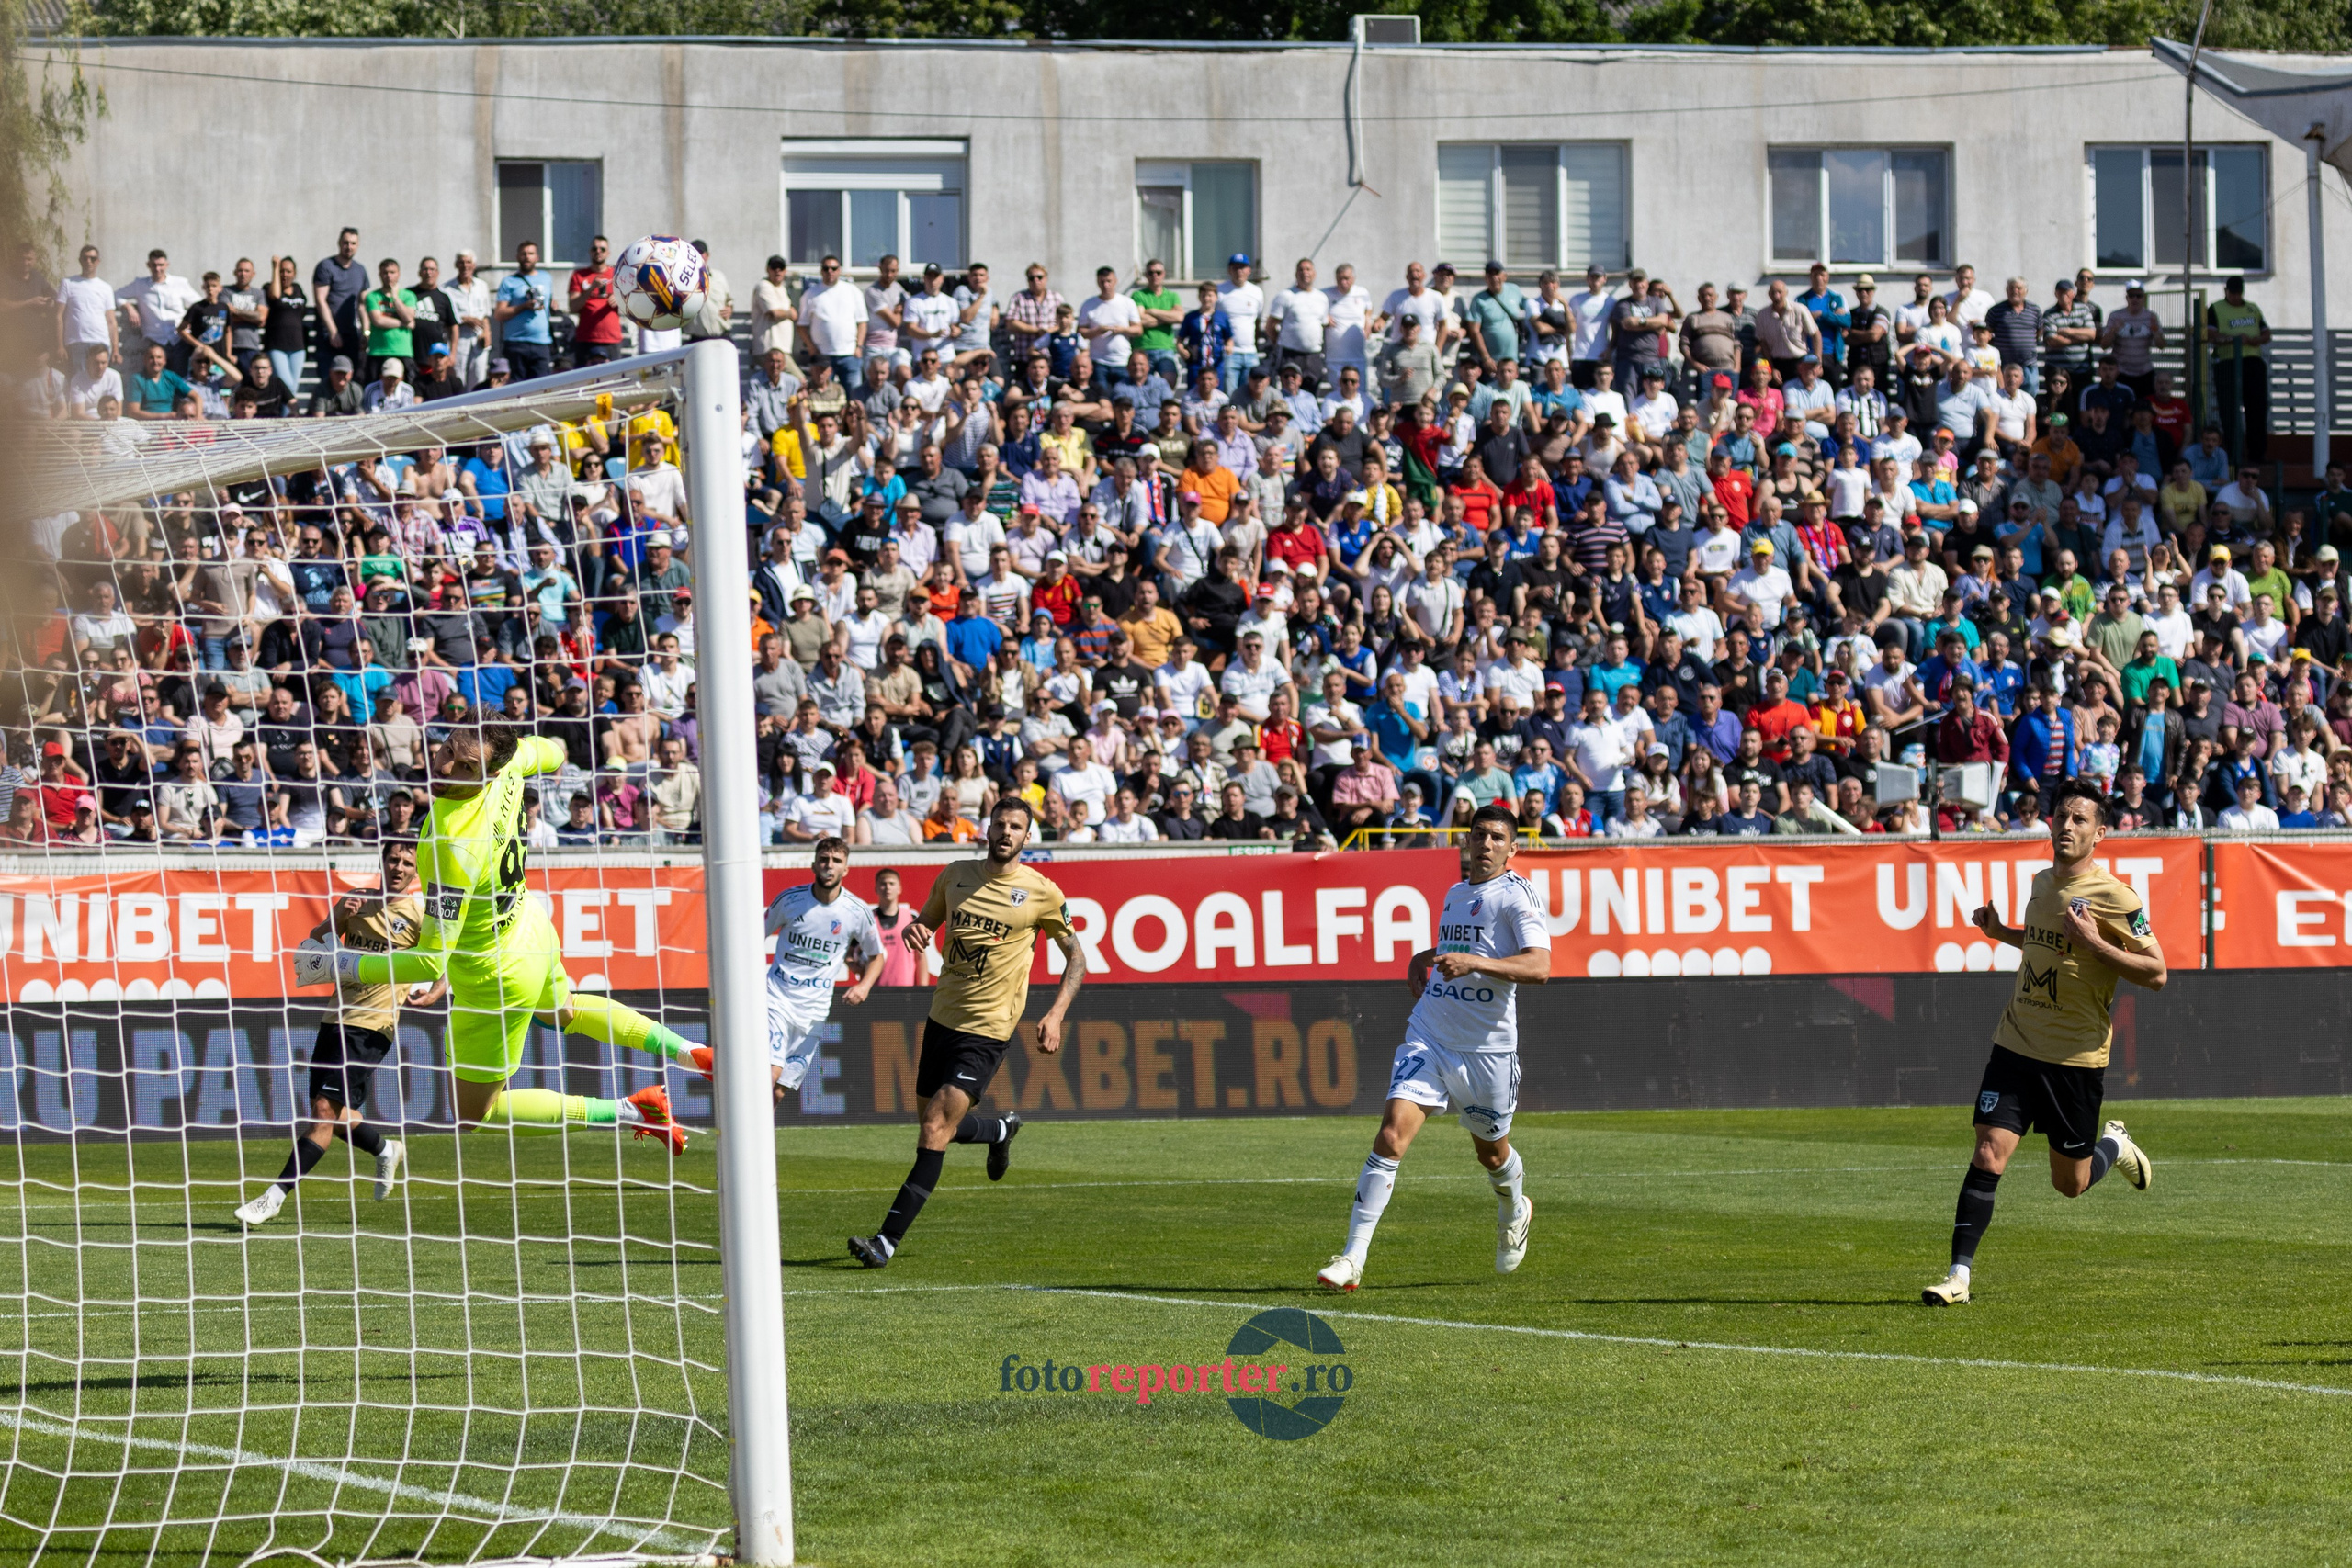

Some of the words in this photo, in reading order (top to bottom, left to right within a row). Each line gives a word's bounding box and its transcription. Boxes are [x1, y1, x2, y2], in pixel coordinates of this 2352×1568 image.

[1530, 865, 1825, 937] UNIBET
[1876, 857, 2164, 931] UNIT
[0, 892, 289, 963] NIBET
[950, 910, 1012, 941] MAXBET
[1438, 924, 1485, 942] NIBET
[788, 931, 841, 953] UNIBET
[774, 966, 831, 989] ELSACO
[1394, 1056, 1426, 1081] 27
